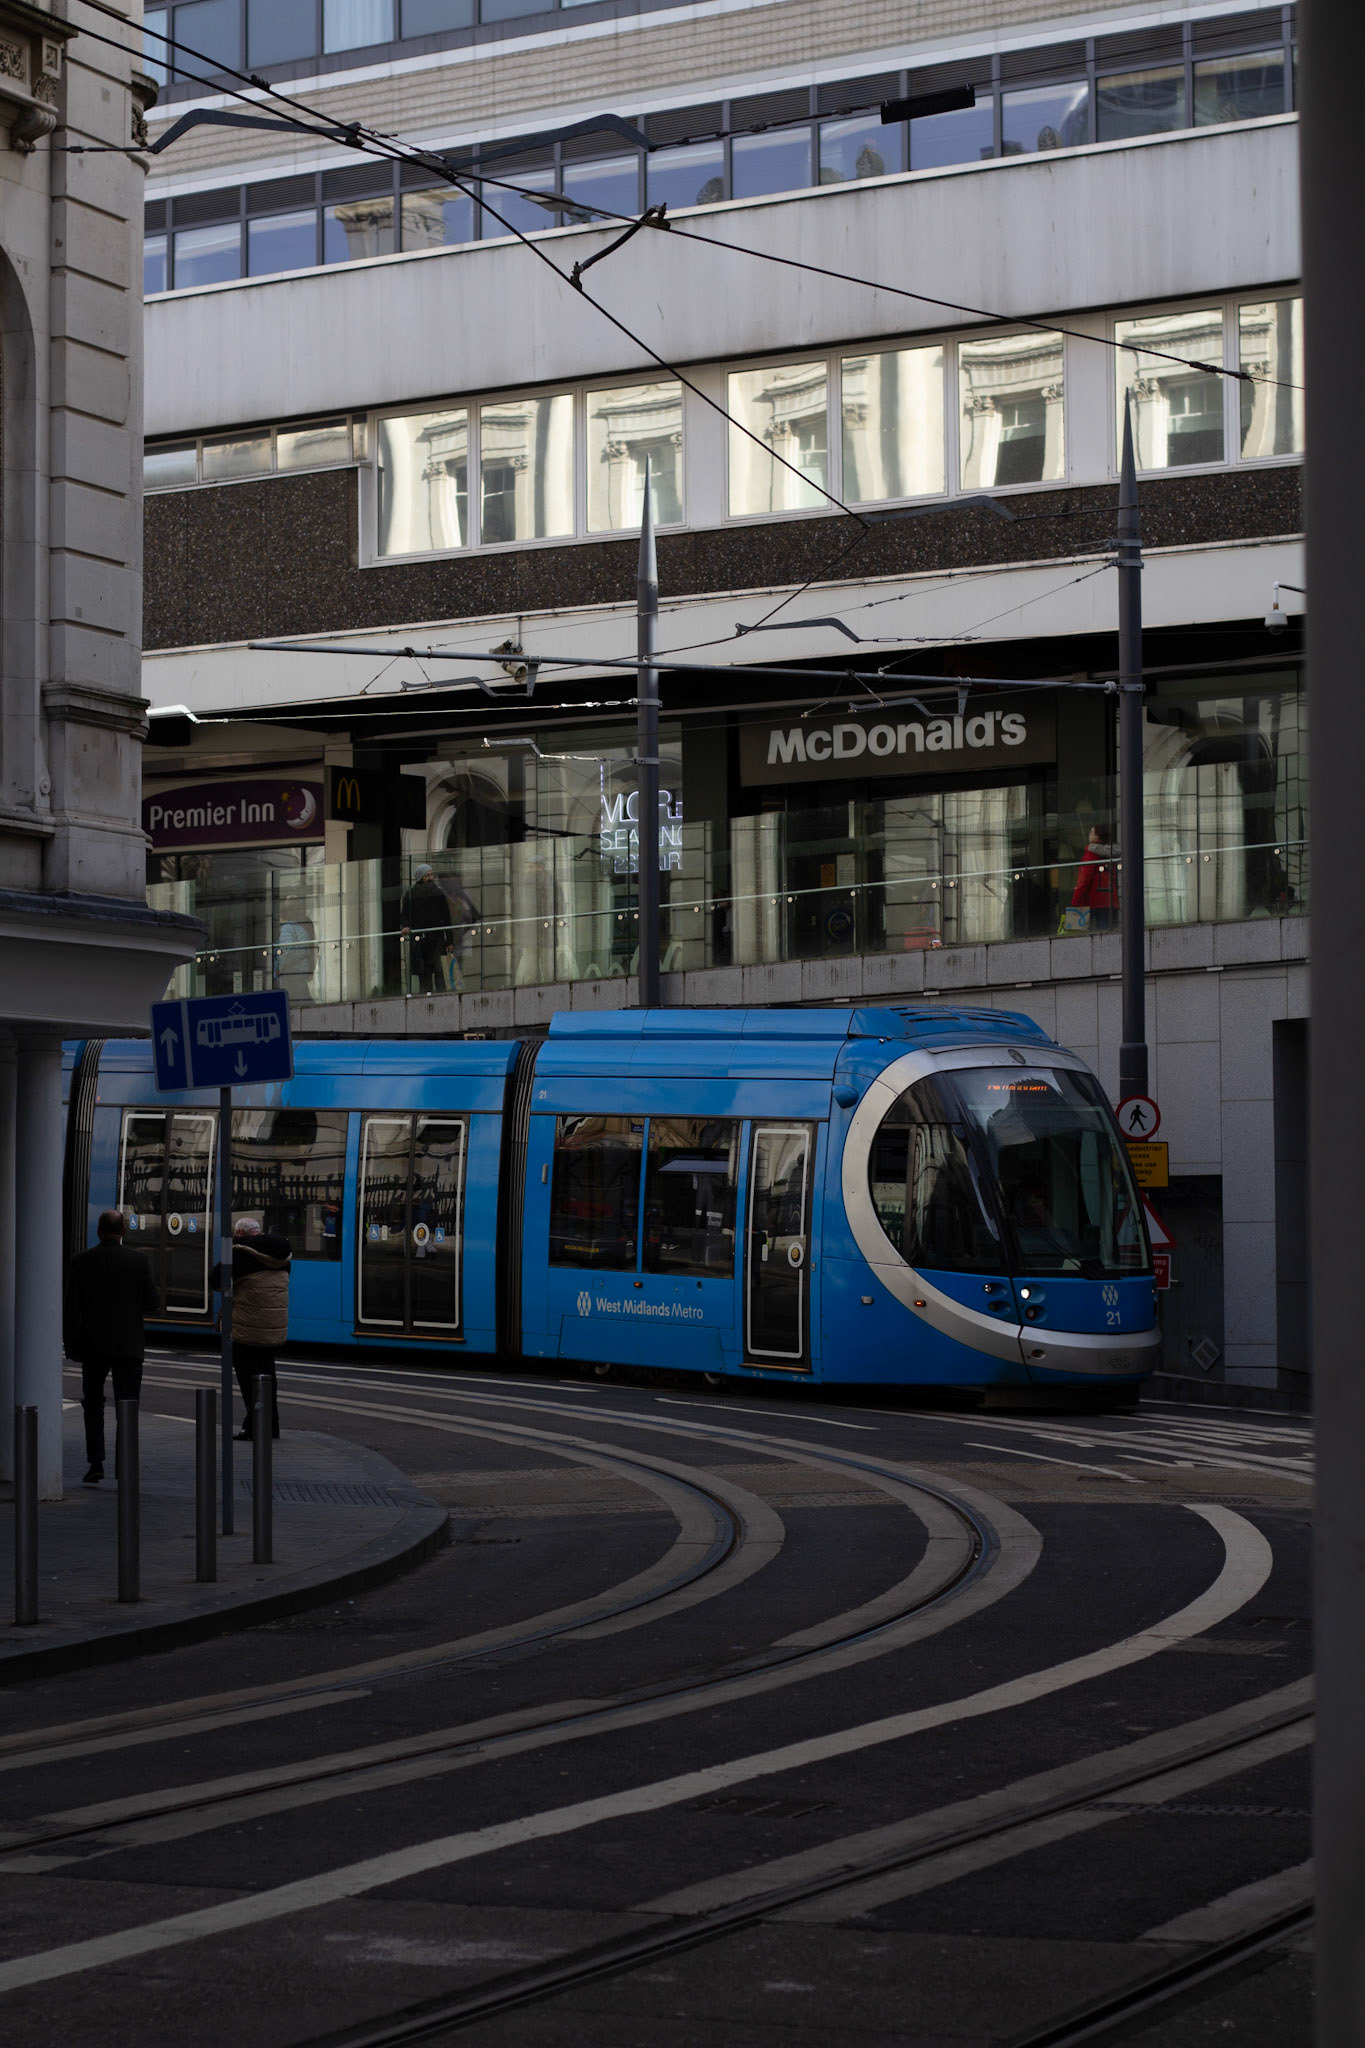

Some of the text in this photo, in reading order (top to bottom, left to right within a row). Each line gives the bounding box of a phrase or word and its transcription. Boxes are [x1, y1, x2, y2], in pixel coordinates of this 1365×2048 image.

[767, 710, 1027, 764] McDonald's
[149, 798, 275, 830] Premier Inn
[595, 1296, 704, 1320] West Midlands Metro
[1106, 1310, 1122, 1327] 21
